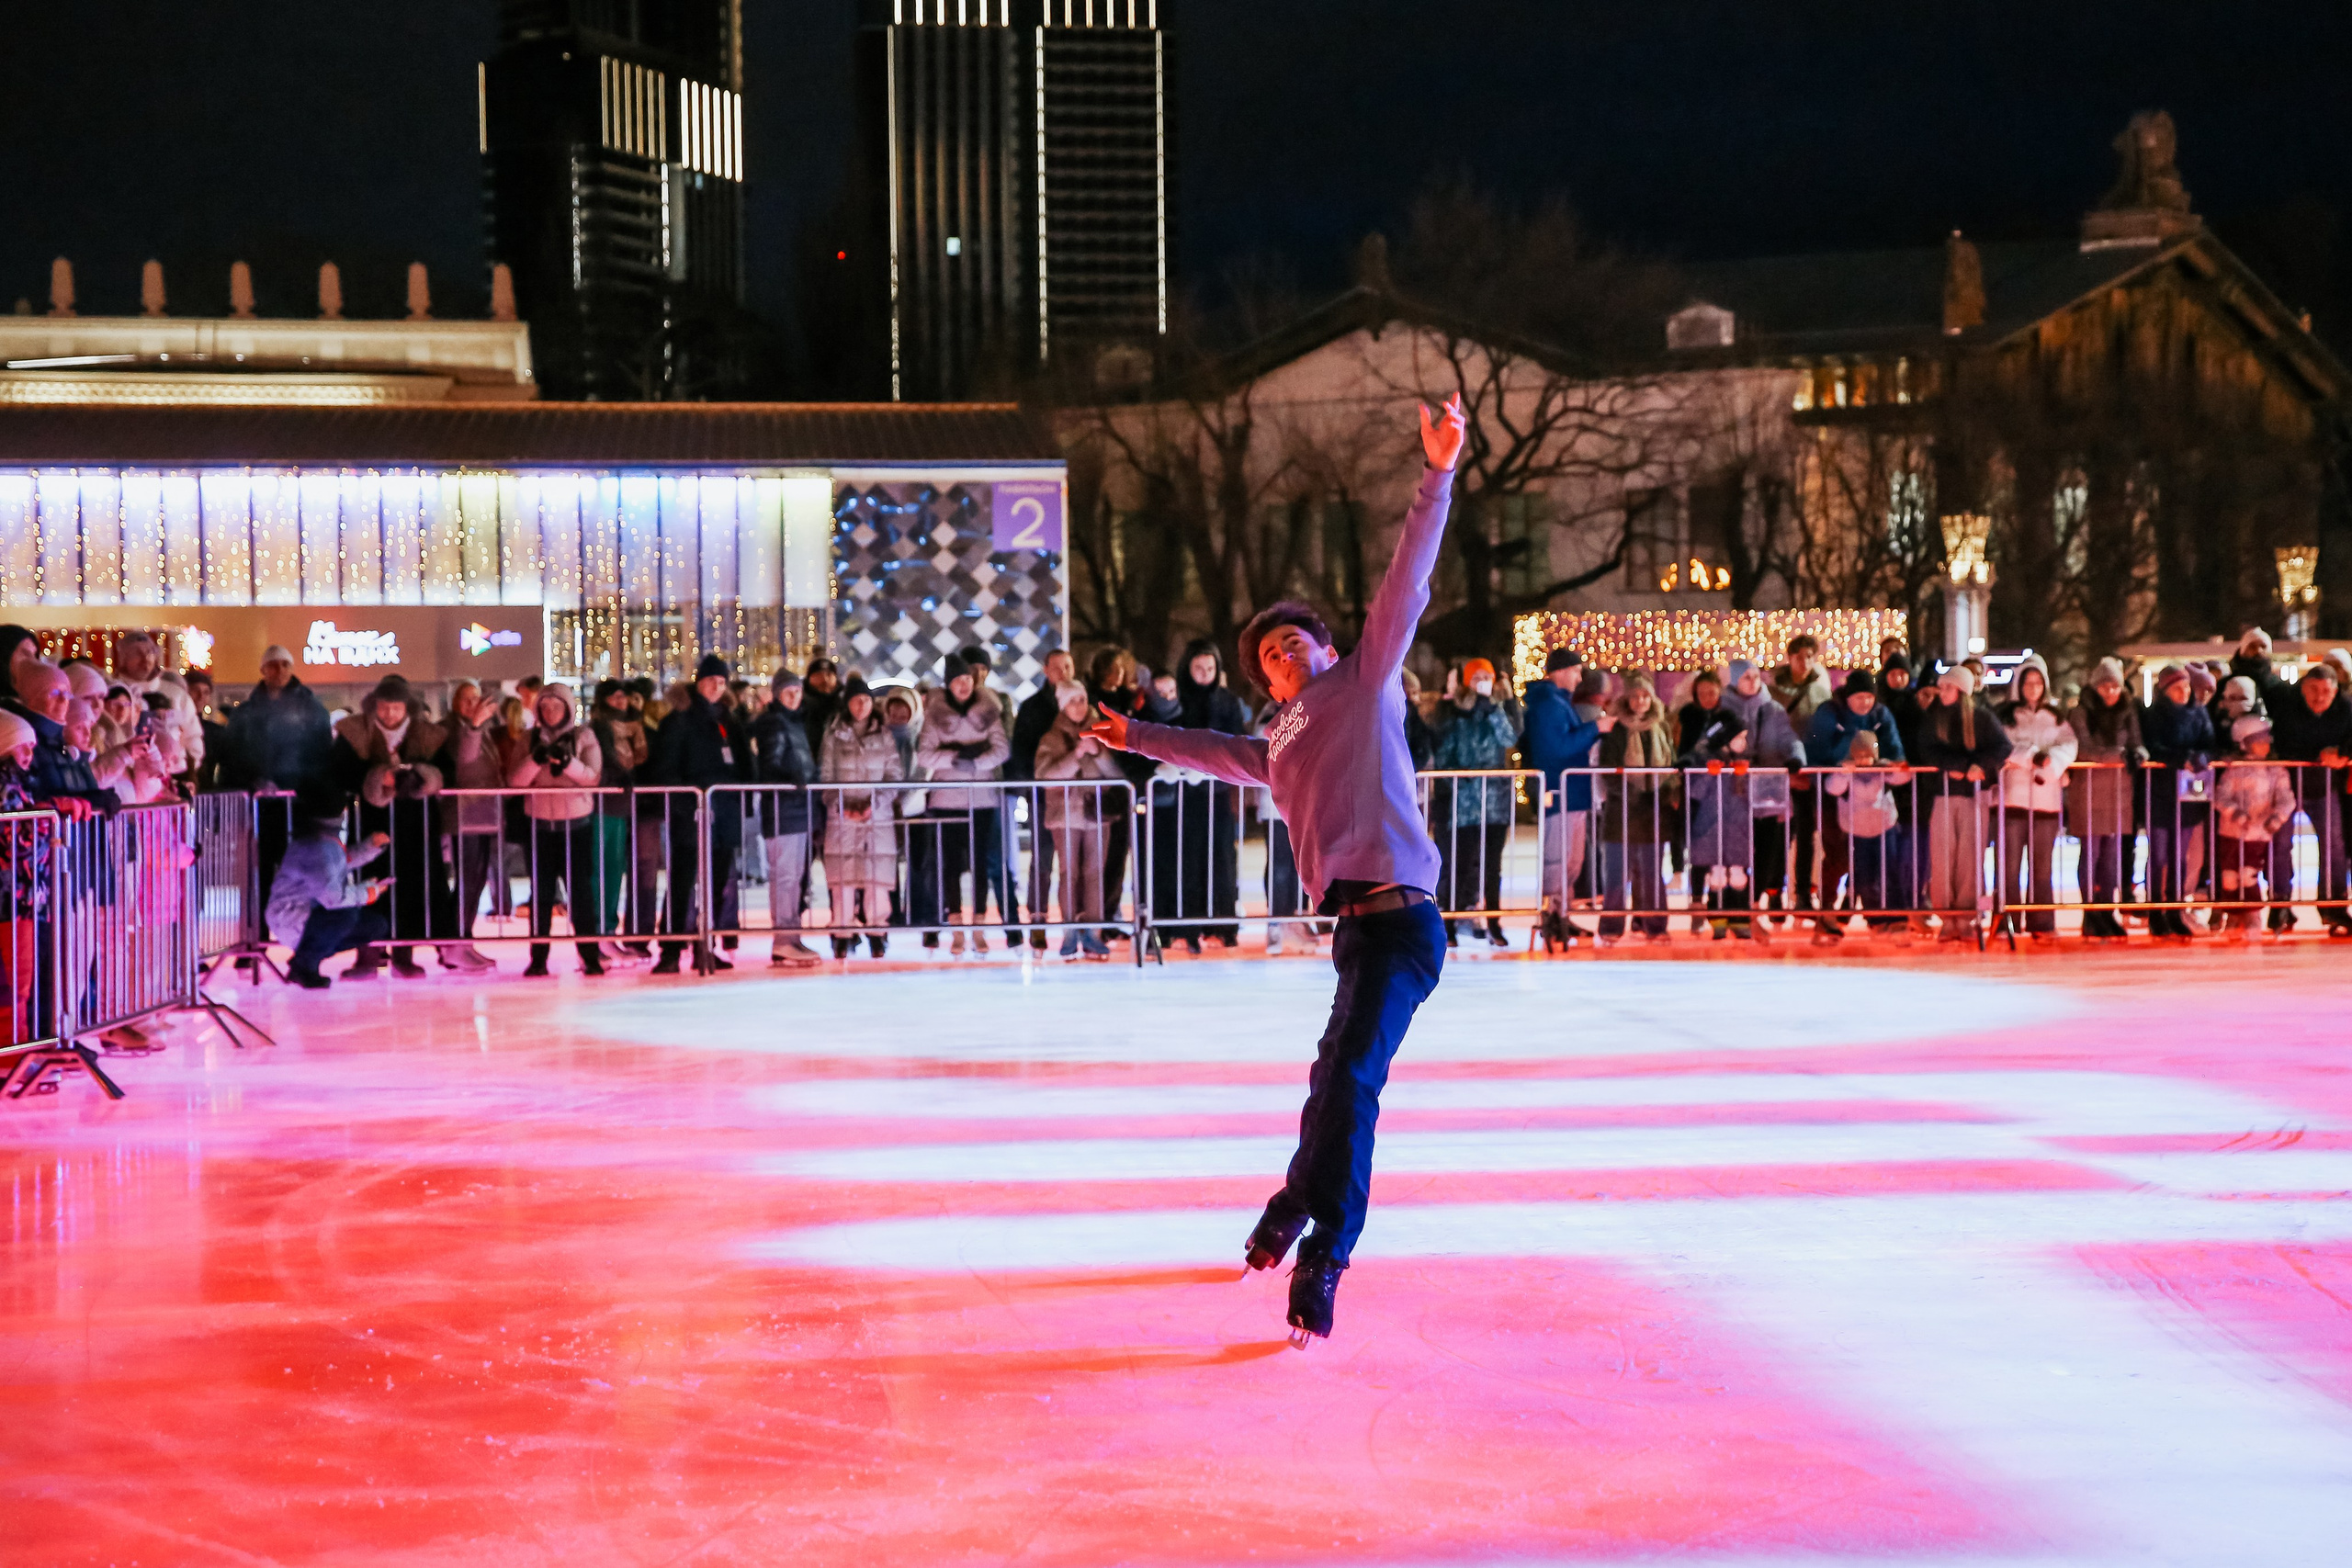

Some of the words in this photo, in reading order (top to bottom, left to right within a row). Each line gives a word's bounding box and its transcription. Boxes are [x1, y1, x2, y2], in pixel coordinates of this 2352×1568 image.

[1012, 497, 1045, 548] 2
[303, 646, 336, 665] НА
[1270, 701, 1304, 744] ковское
